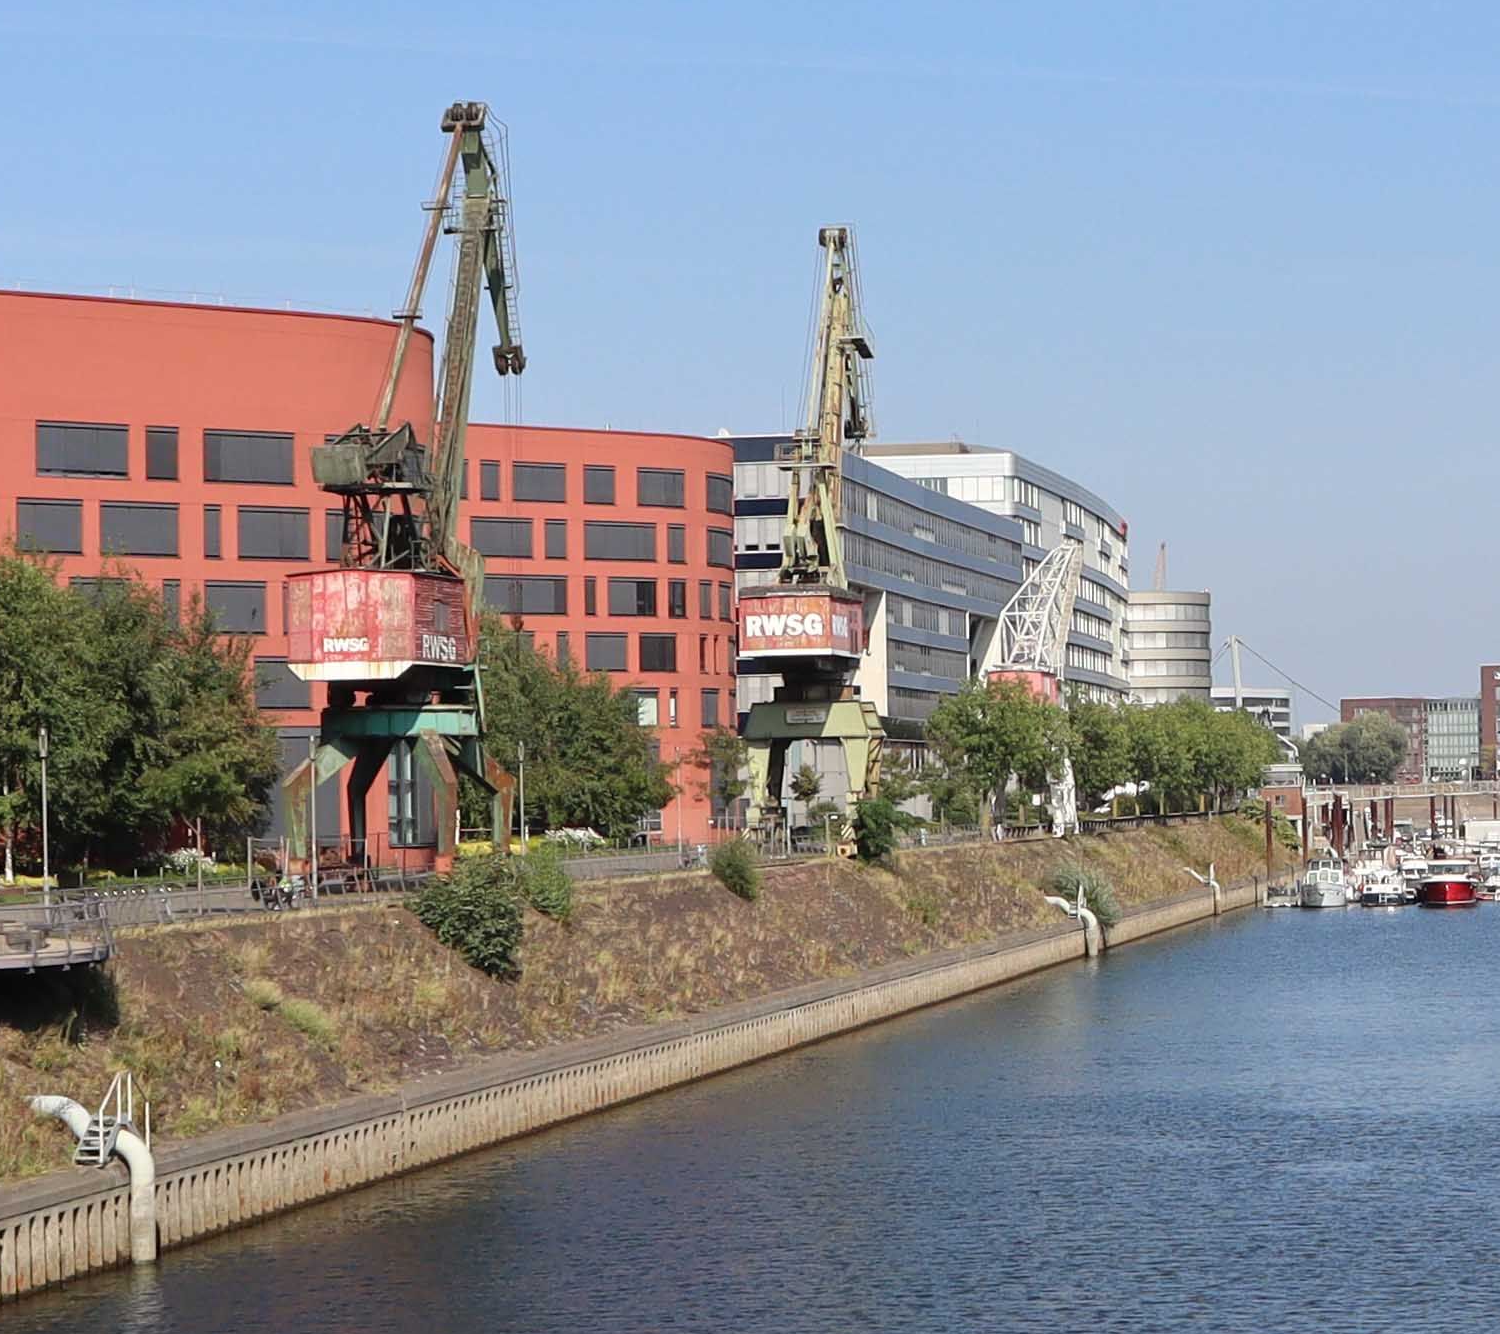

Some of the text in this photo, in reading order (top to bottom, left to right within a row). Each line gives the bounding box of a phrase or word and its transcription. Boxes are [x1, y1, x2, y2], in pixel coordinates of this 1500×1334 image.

[745, 613, 823, 637] RWSG
[323, 637, 370, 652] RWSG
[423, 635, 457, 660] RWSG
